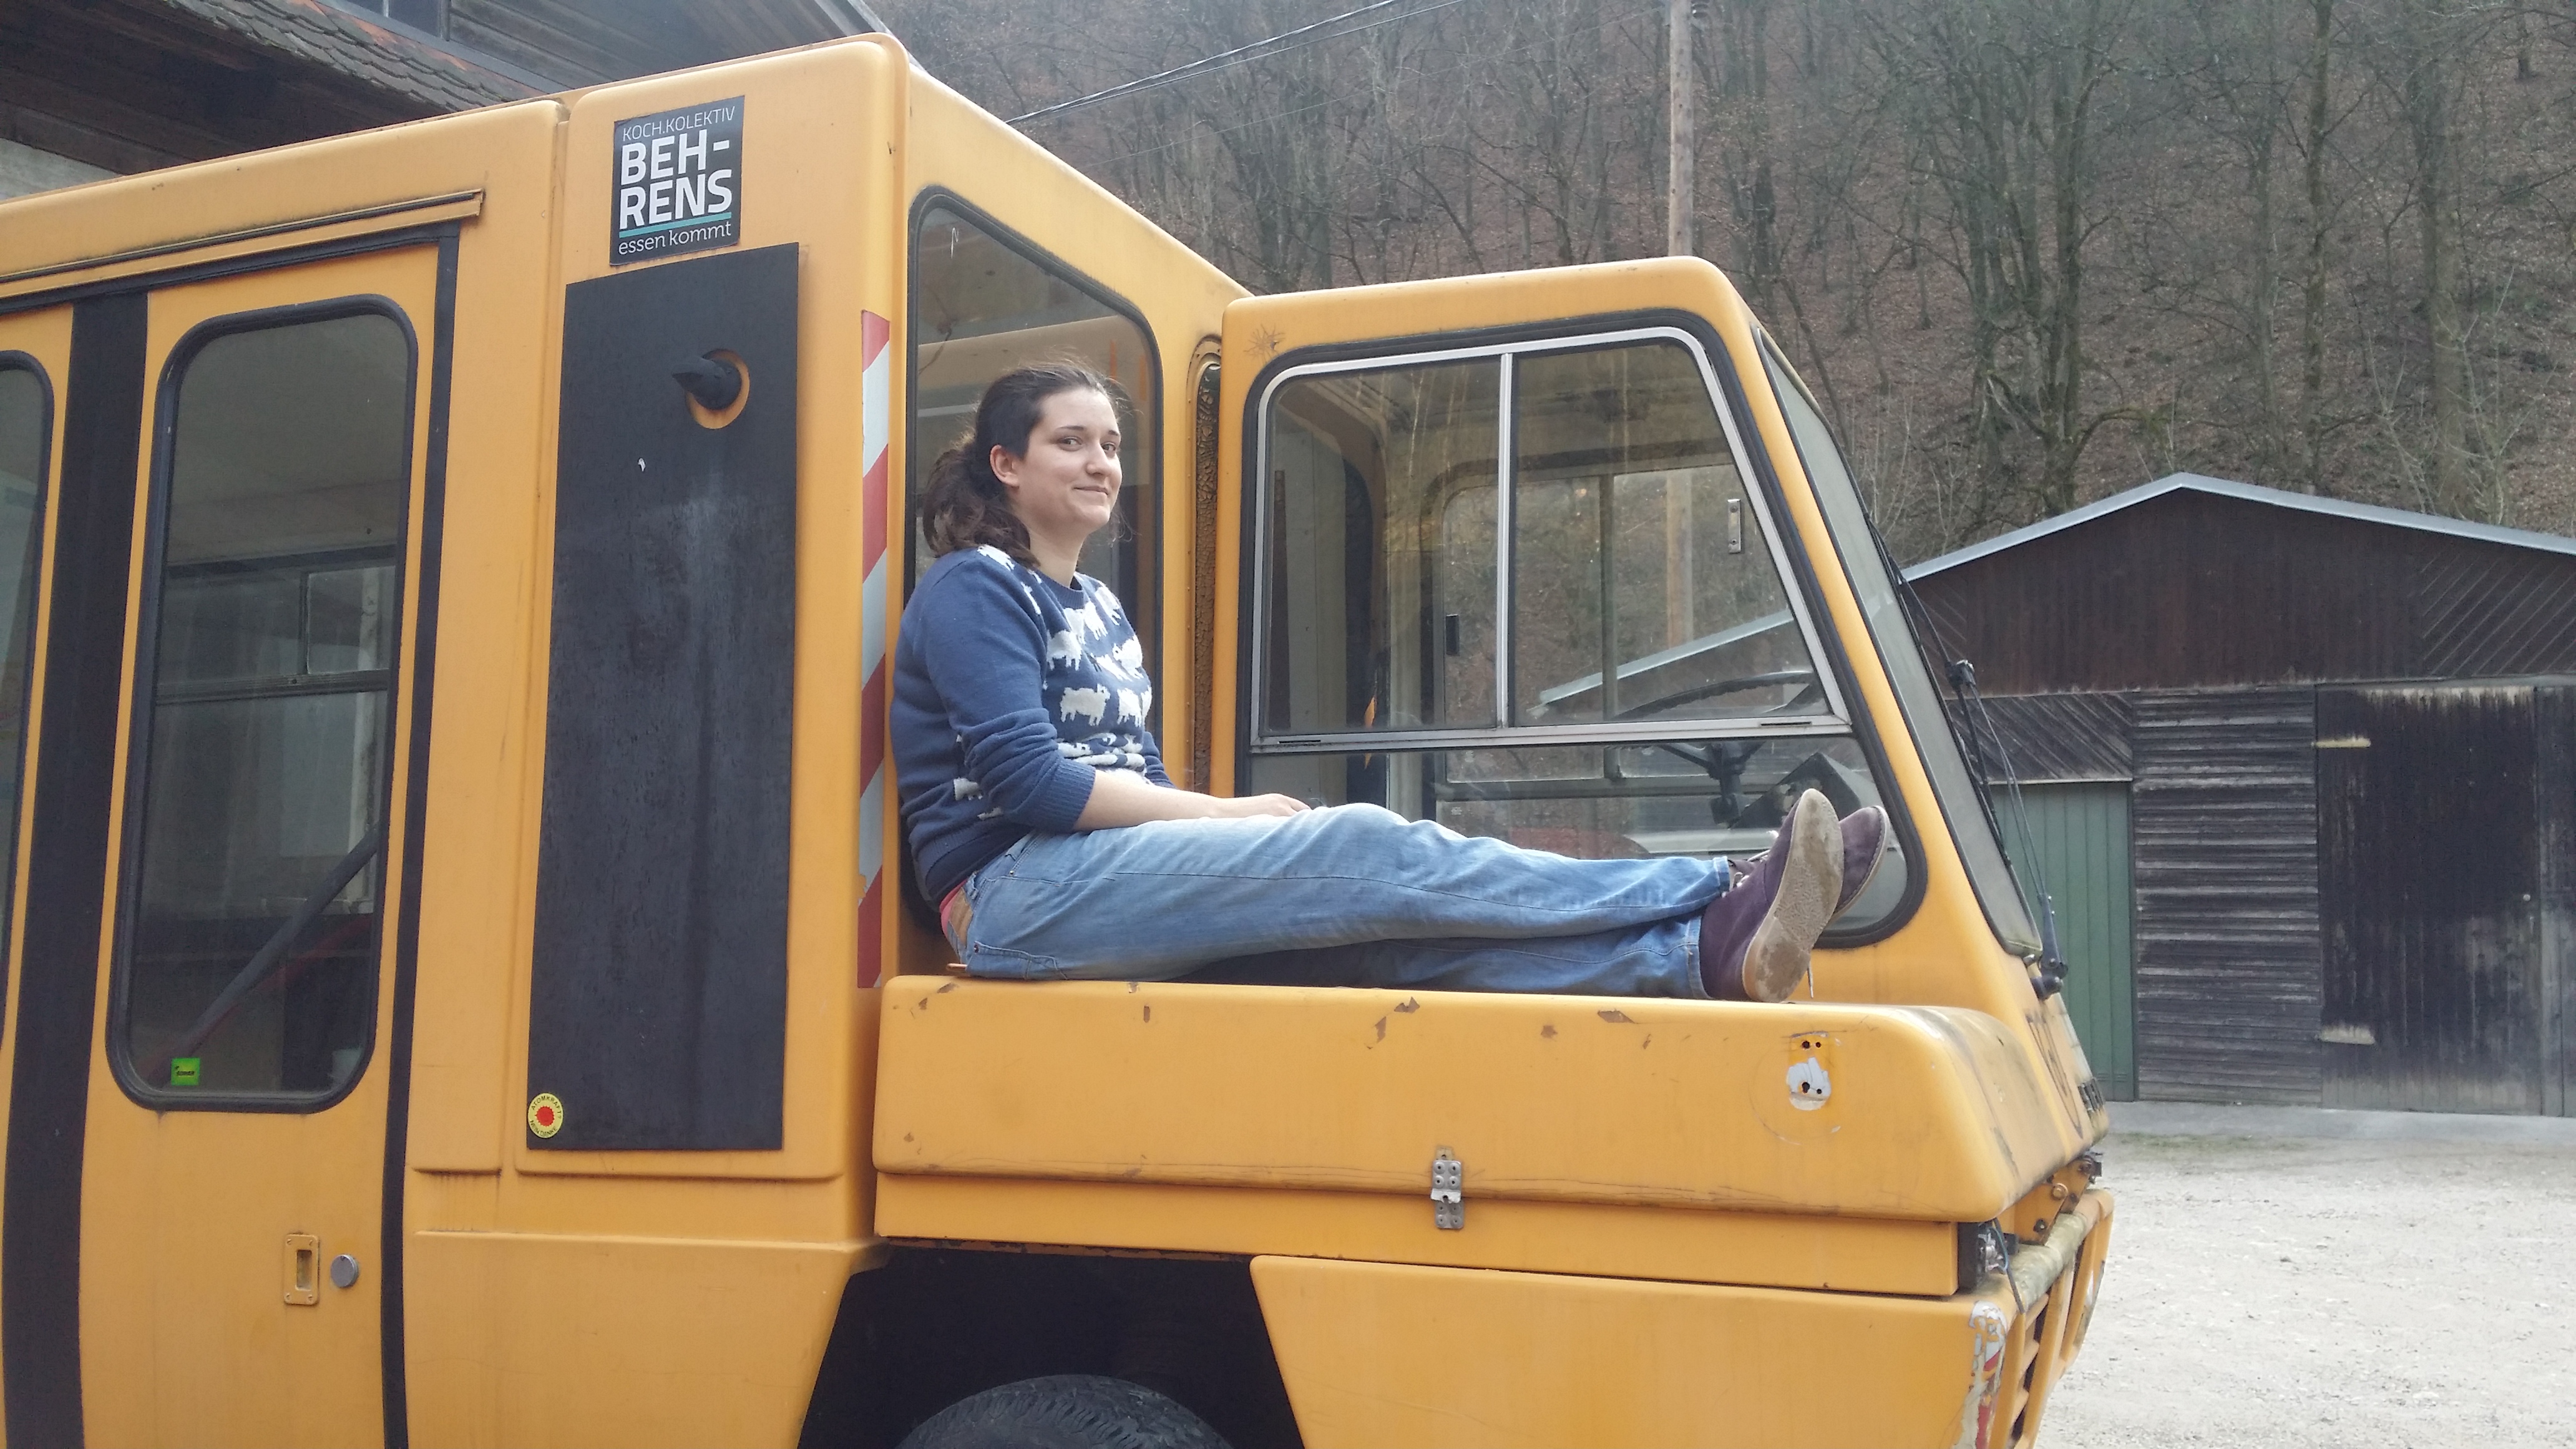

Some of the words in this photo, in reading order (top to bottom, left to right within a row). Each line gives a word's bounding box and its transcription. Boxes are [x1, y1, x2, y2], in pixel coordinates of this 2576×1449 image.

[620, 129, 730, 186] BEH-
[619, 168, 733, 230] RENS
[618, 236, 666, 255] essen
[669, 221, 731, 246] kommt
